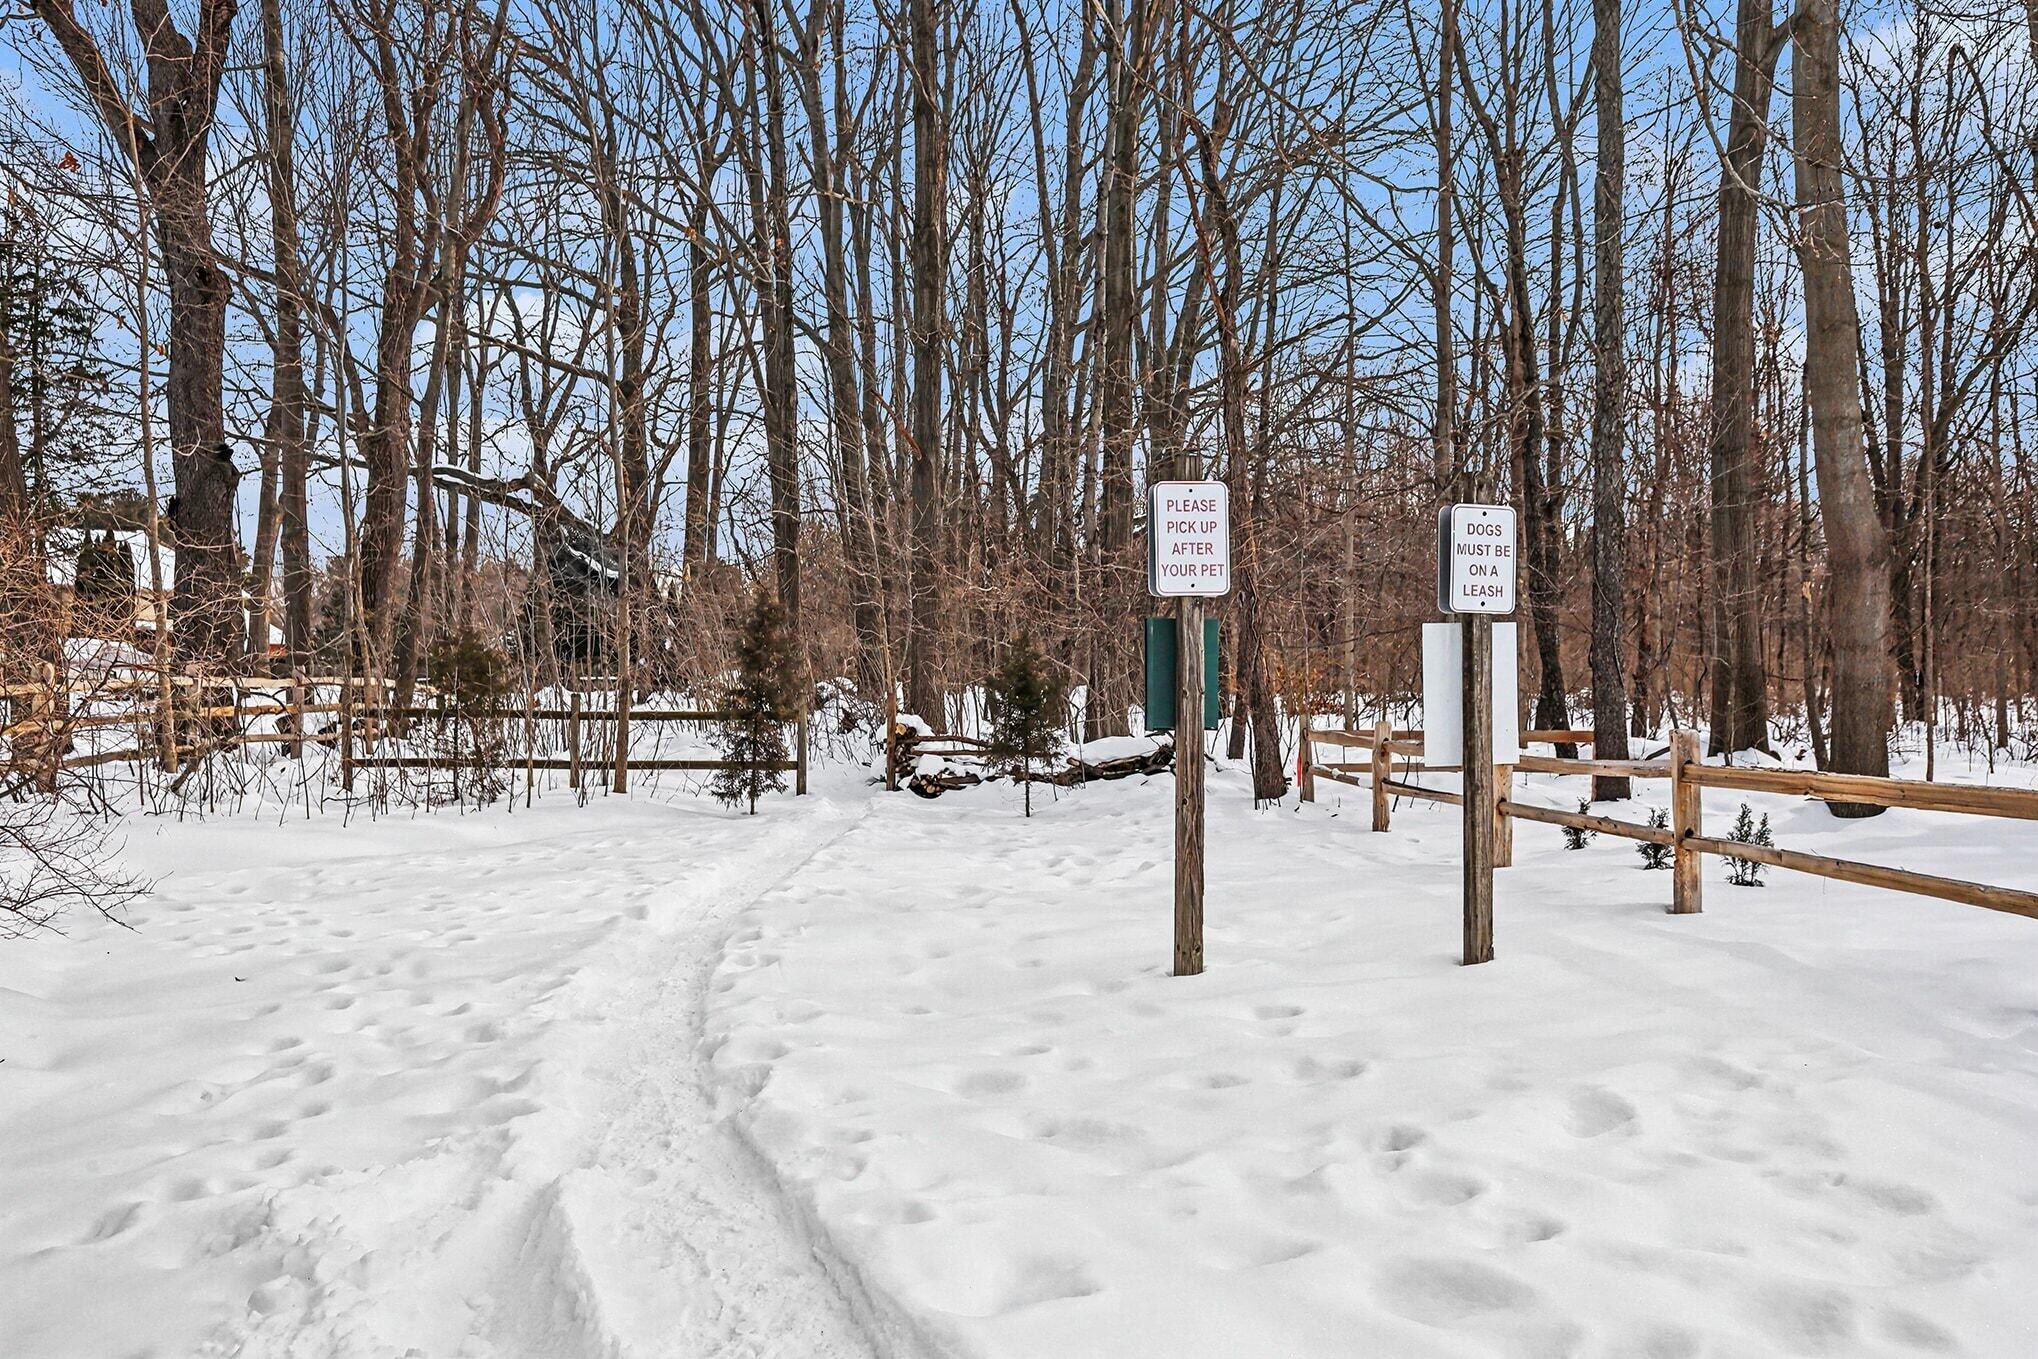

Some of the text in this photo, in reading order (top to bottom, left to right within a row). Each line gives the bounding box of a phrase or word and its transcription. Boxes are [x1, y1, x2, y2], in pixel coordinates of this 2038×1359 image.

[1167, 500, 1217, 512] PLEASE
[1167, 521, 1217, 533] PICK UP
[1467, 523, 1502, 536] DOGS
[1172, 543, 1213, 555] AFTER
[1457, 543, 1510, 557] MUST BE
[1162, 564, 1225, 576] YOUR PET
[1470, 564, 1498, 577] ON A
[1463, 584, 1503, 597] LEASH
